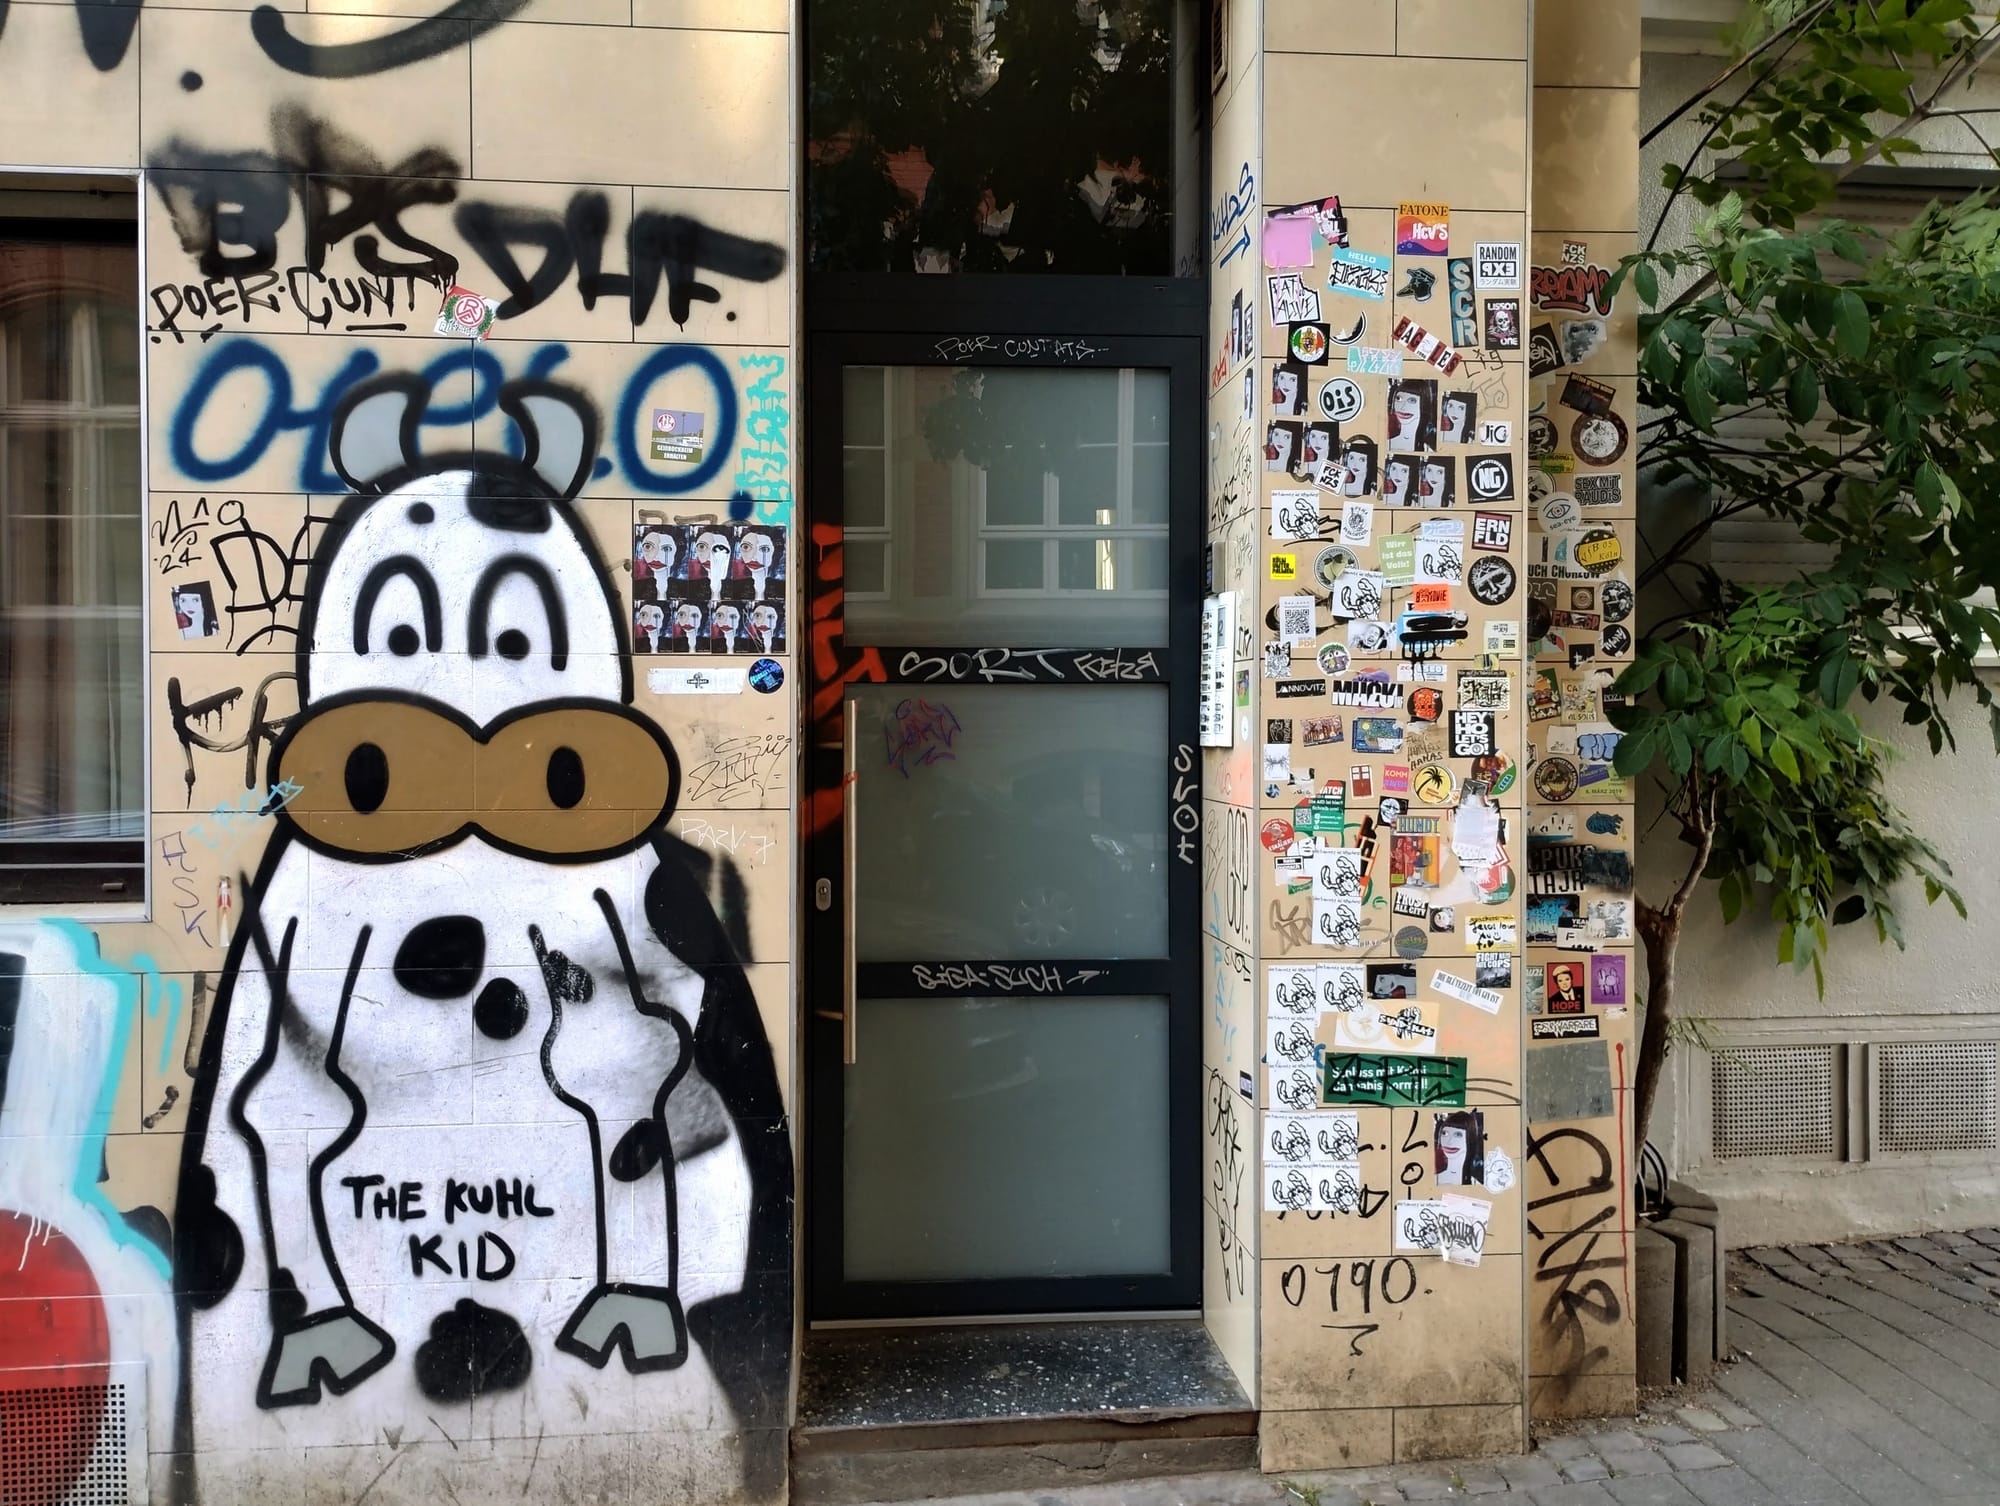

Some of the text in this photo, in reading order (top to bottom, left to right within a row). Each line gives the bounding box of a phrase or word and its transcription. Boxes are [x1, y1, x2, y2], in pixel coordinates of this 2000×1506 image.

[1400, 203, 1448, 217] FATONE
[1479, 246, 1516, 260] RANDOM
[1562, 243, 1587, 255] FCK
[1348, 251, 1376, 264] HELLO
[1561, 253, 1585, 265] NZS
[1322, 464, 1343, 478] FCK
[1319, 475, 1340, 489] NZS
[1575, 476, 1598, 490] SEX
[1475, 517, 1510, 534] ERN
[1549, 516, 1577, 530] sea-eye
[1473, 530, 1509, 547] FLD
[1455, 711, 1487, 724] HEY
[1455, 723, 1489, 735] HO
[1455, 734, 1489, 744] LET'S
[1455, 743, 1489, 756] GO!
[1394, 904, 1427, 917] ALL CITY
[1476, 953, 1499, 962] FIGHT
[1487, 959, 1511, 968] COPS
[1552, 1001, 1581, 1011] HOPE
[341, 1174, 554, 1224] THE KUHL
[408, 1230, 516, 1282] KID
